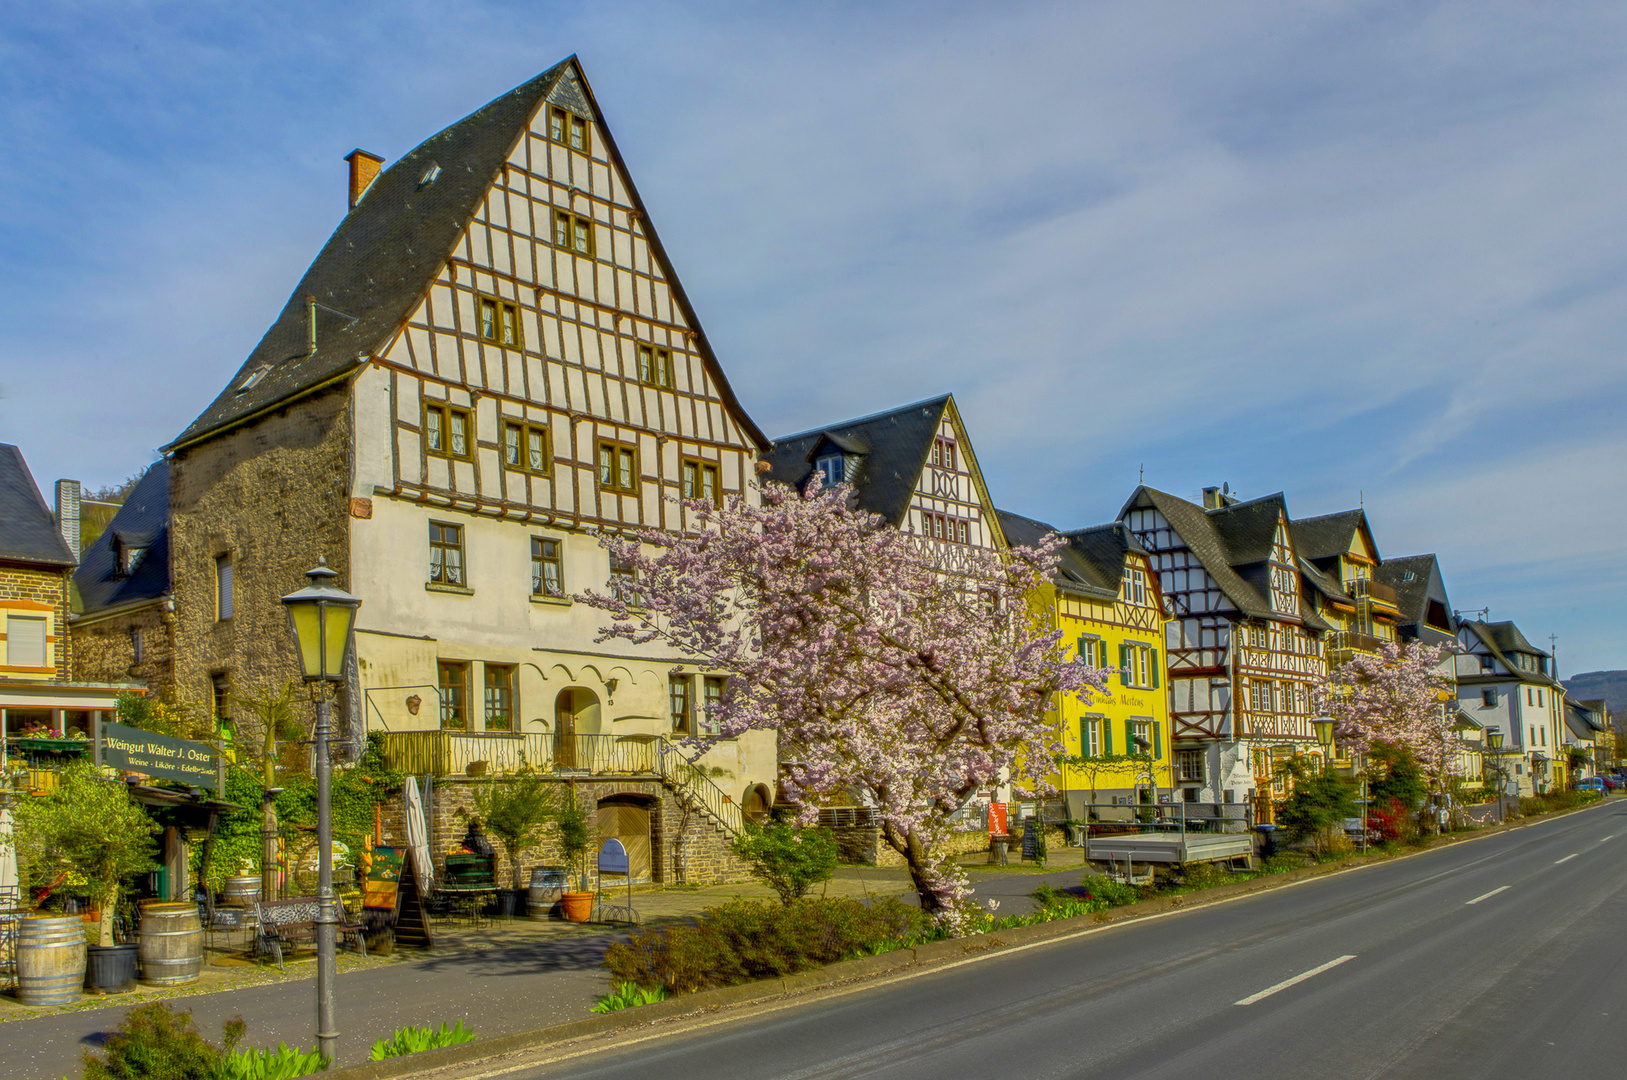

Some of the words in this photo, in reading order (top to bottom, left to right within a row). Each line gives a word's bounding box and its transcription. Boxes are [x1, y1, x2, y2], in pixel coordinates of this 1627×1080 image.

[1120, 694, 1144, 708] Mertens
[107, 737, 145, 754] Weingut
[147, 743, 176, 757] Walter
[177, 748, 185, 758] J.
[187, 749, 210, 762] Oster
[128, 757, 148, 766] Weine
[155, 761, 175, 770] Liköre
[181, 764, 216, 775] Edelbrände
